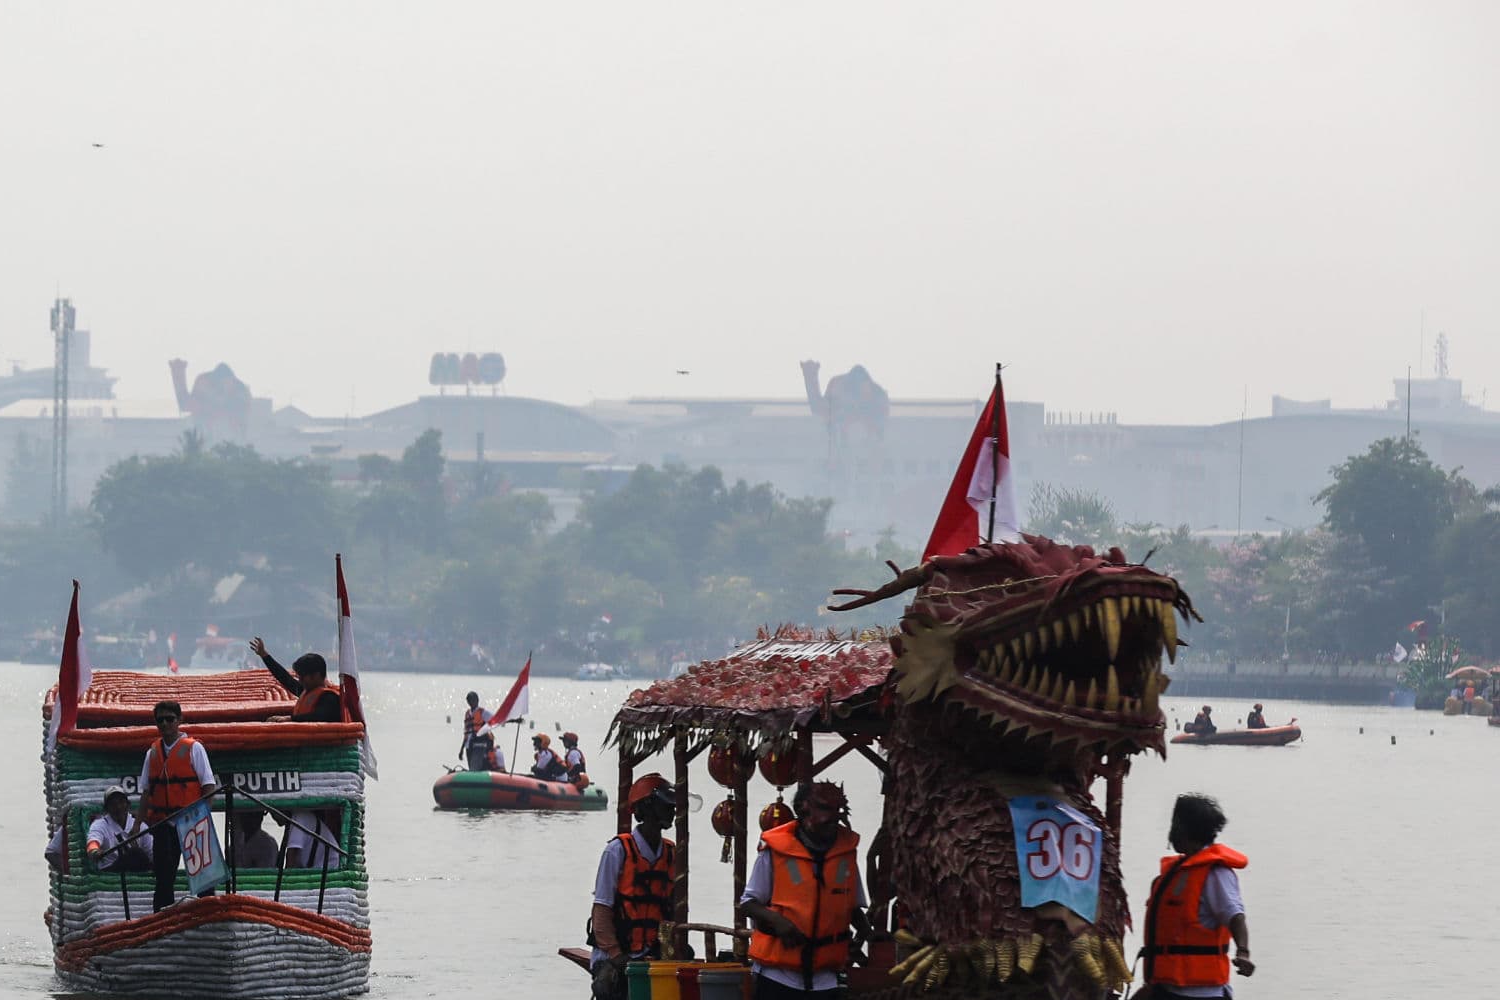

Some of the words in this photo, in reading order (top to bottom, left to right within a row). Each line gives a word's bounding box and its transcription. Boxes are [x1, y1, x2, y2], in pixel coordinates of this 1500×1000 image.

[233, 771, 300, 791] PUTIH
[183, 815, 212, 877] 37
[1027, 818, 1094, 880] 36
